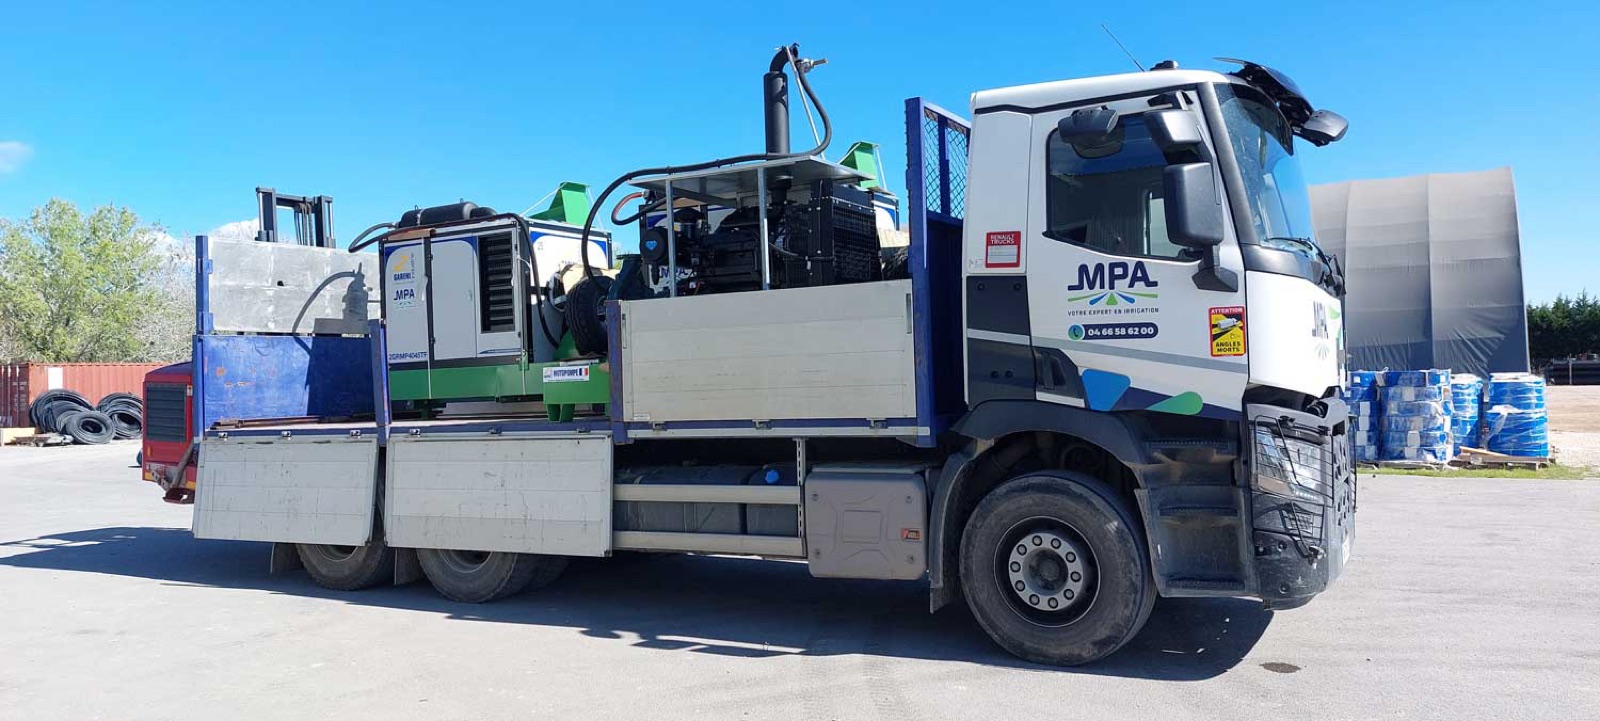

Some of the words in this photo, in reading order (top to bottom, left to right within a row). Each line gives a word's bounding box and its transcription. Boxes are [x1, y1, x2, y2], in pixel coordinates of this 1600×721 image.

[1068, 261, 1158, 291] MPA
[393, 288, 415, 301] MPA
[1088, 308, 1112, 316] EXPERT
[1124, 307, 1159, 315] IRRIGATION
[1088, 328, 1100, 336] 04
[1127, 327, 1139, 335] 62
